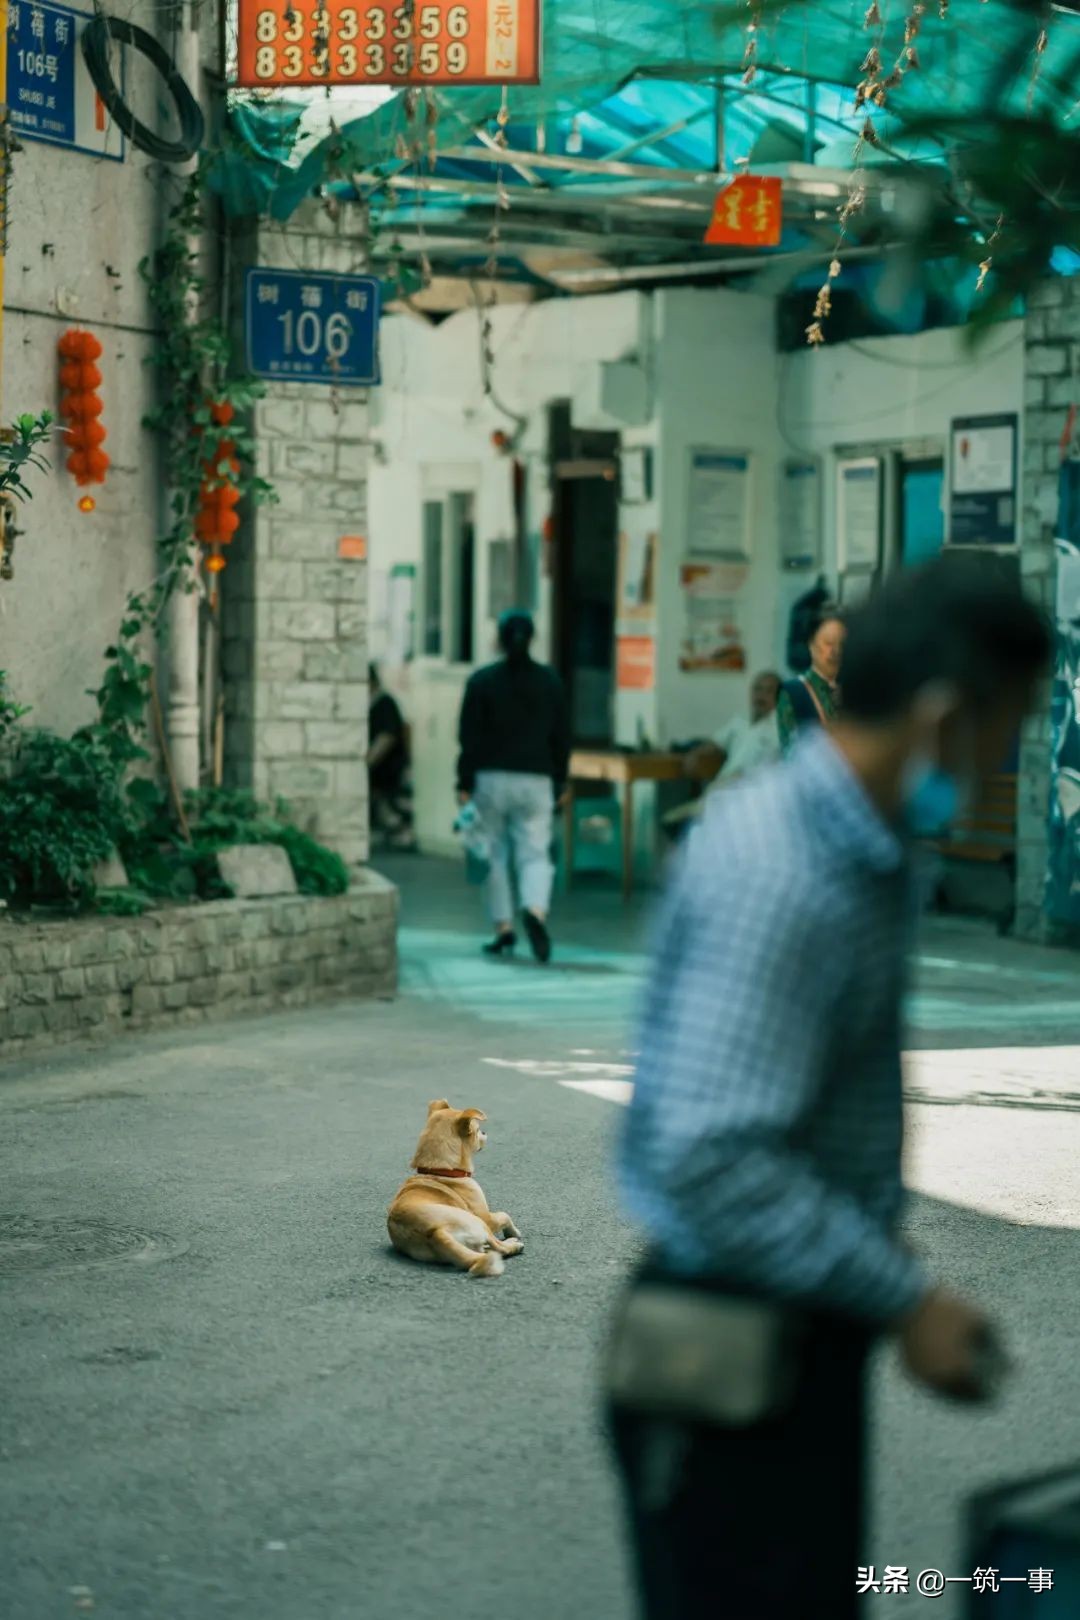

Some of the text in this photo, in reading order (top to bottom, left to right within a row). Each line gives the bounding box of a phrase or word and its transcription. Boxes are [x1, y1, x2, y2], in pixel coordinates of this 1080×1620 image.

[255, 6, 470, 43] 83333356
[18, 49, 58, 83] 106号
[254, 41, 469, 79] 83333359
[277, 309, 350, 358] 106
